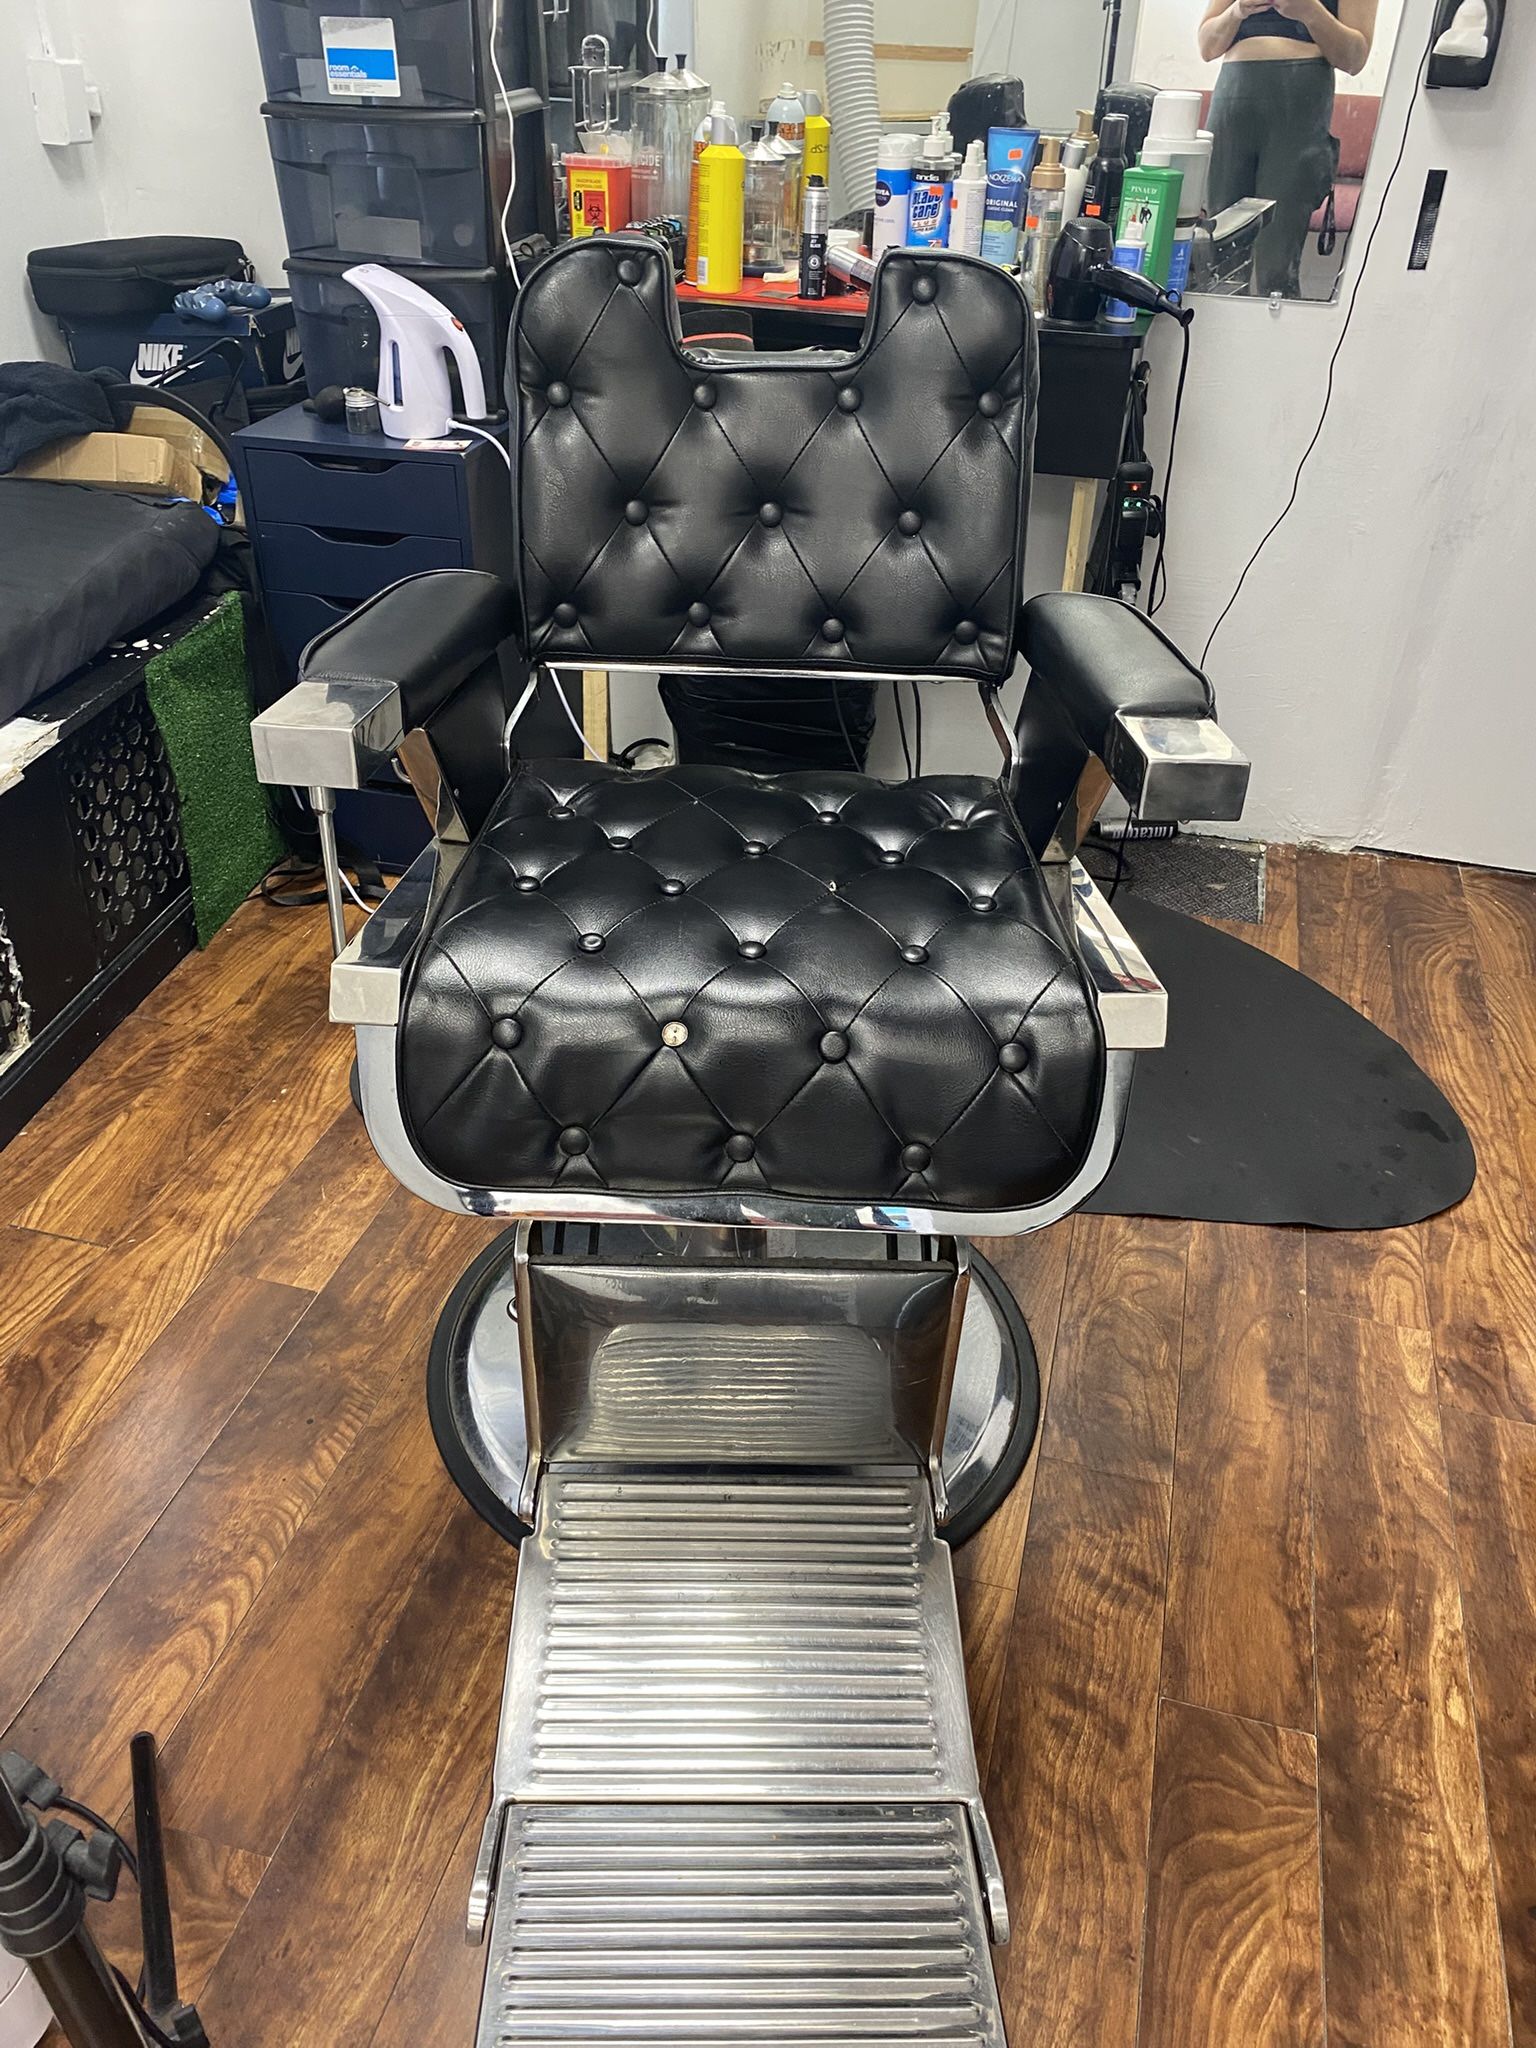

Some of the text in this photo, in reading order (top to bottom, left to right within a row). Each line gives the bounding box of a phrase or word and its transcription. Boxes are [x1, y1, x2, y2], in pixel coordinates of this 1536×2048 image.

[330, 70, 368, 78] essentials
[986, 199, 1018, 208] ORIGINAL
[137, 343, 184, 371] NIKE
